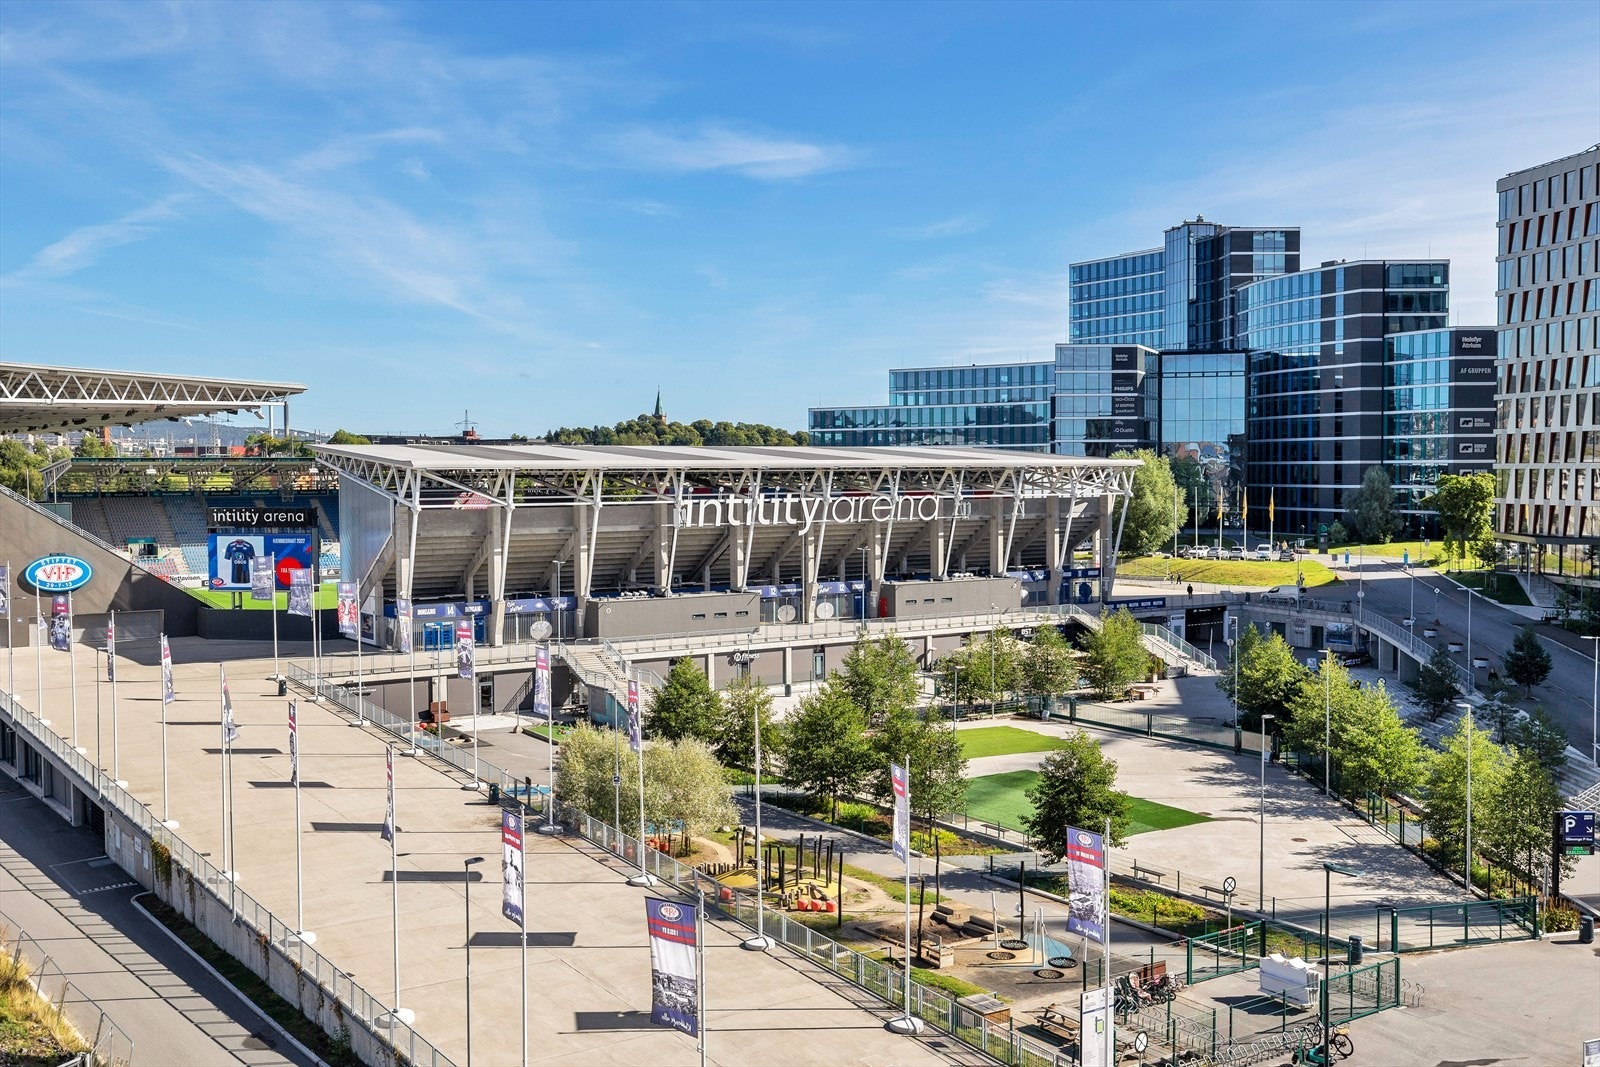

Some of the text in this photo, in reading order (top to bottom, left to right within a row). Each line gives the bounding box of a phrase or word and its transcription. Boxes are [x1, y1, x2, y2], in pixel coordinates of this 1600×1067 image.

[212, 508, 304, 525] intility arena
[685, 486, 940, 536] intility arena
[1565, 819, 1576, 833] P
